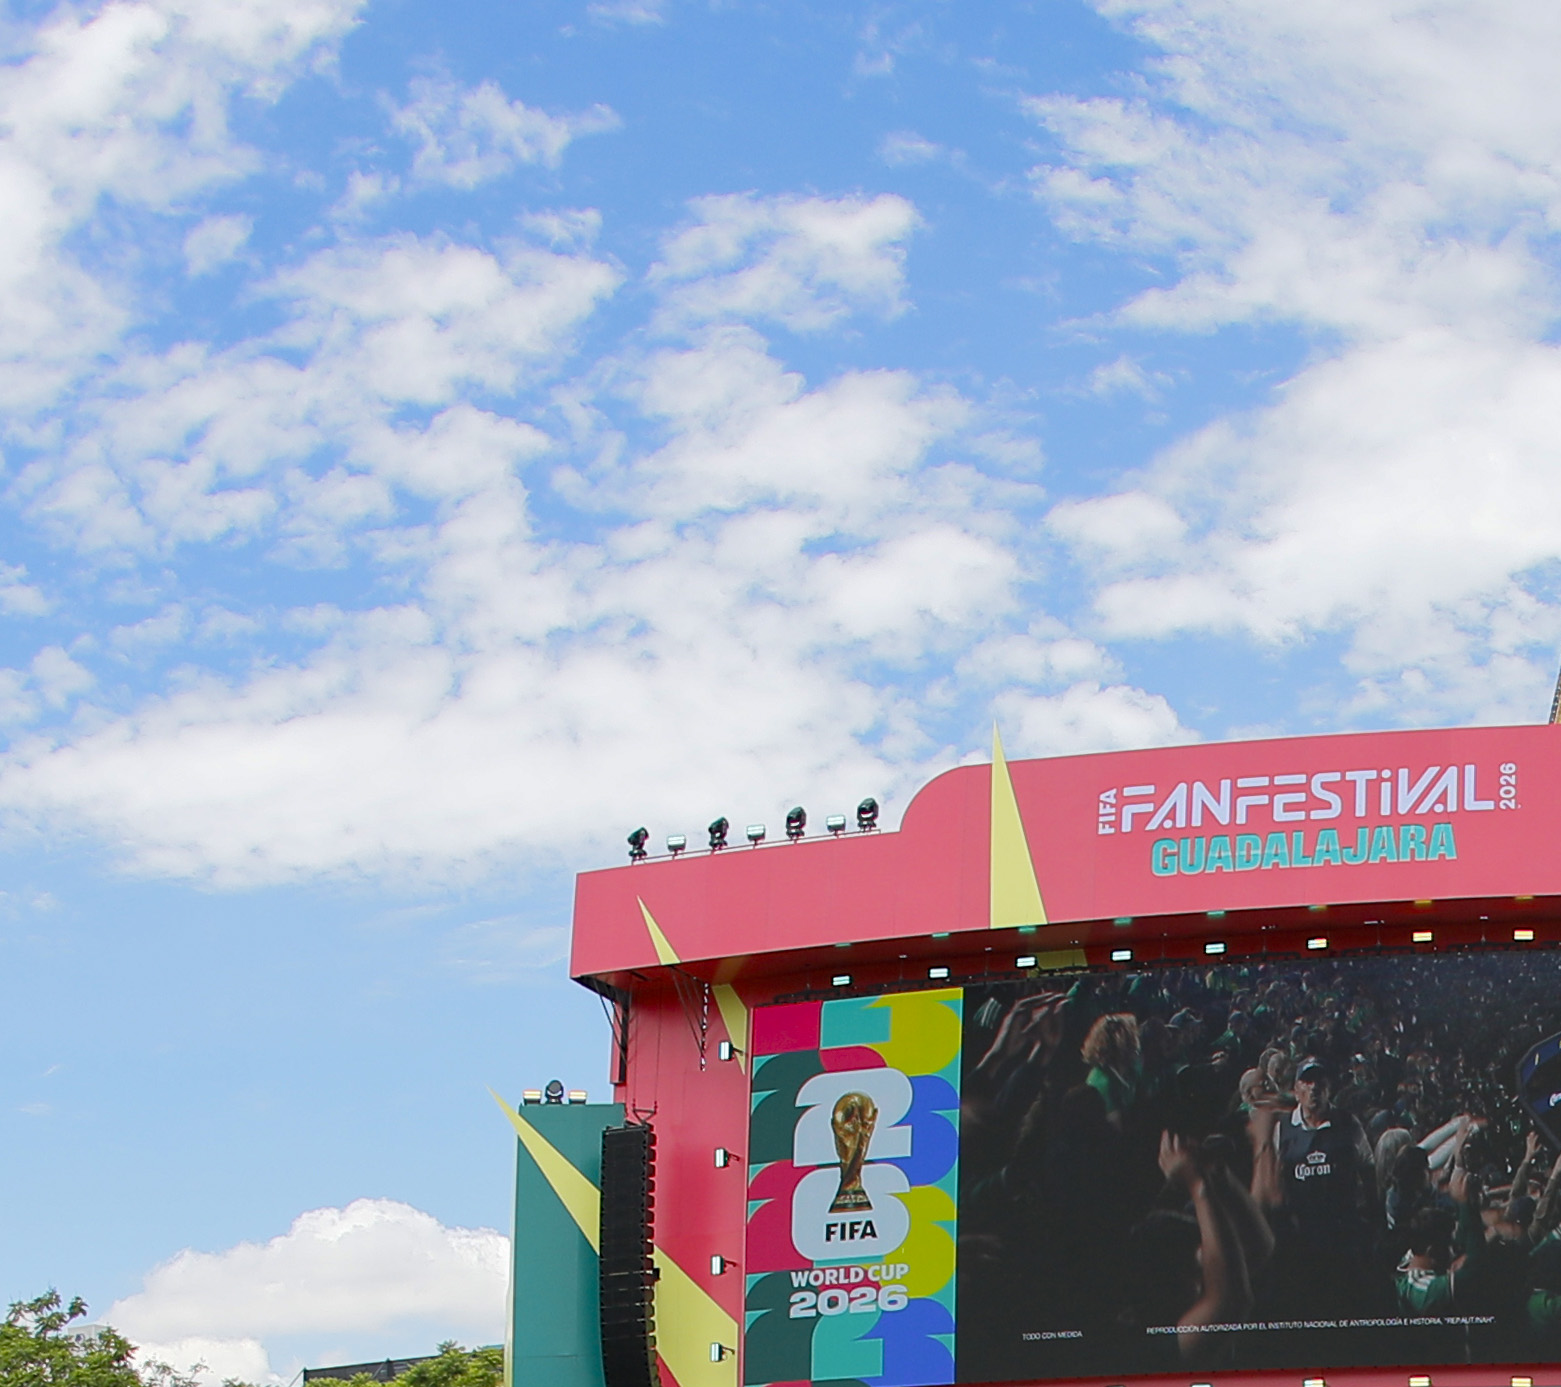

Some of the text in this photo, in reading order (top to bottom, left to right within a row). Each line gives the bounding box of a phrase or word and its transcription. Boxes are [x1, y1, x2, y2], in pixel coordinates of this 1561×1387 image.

[1098, 788, 1118, 835] FIFA
[1499, 762, 1517, 810] 2026
[1151, 823, 1457, 877] GUADALAJARA
[1295, 1164, 1331, 1181] Coron
[825, 1220, 878, 1242] FIFA
[790, 1263, 909, 1288] WORLD CUP
[789, 1284, 909, 1319] 2026
